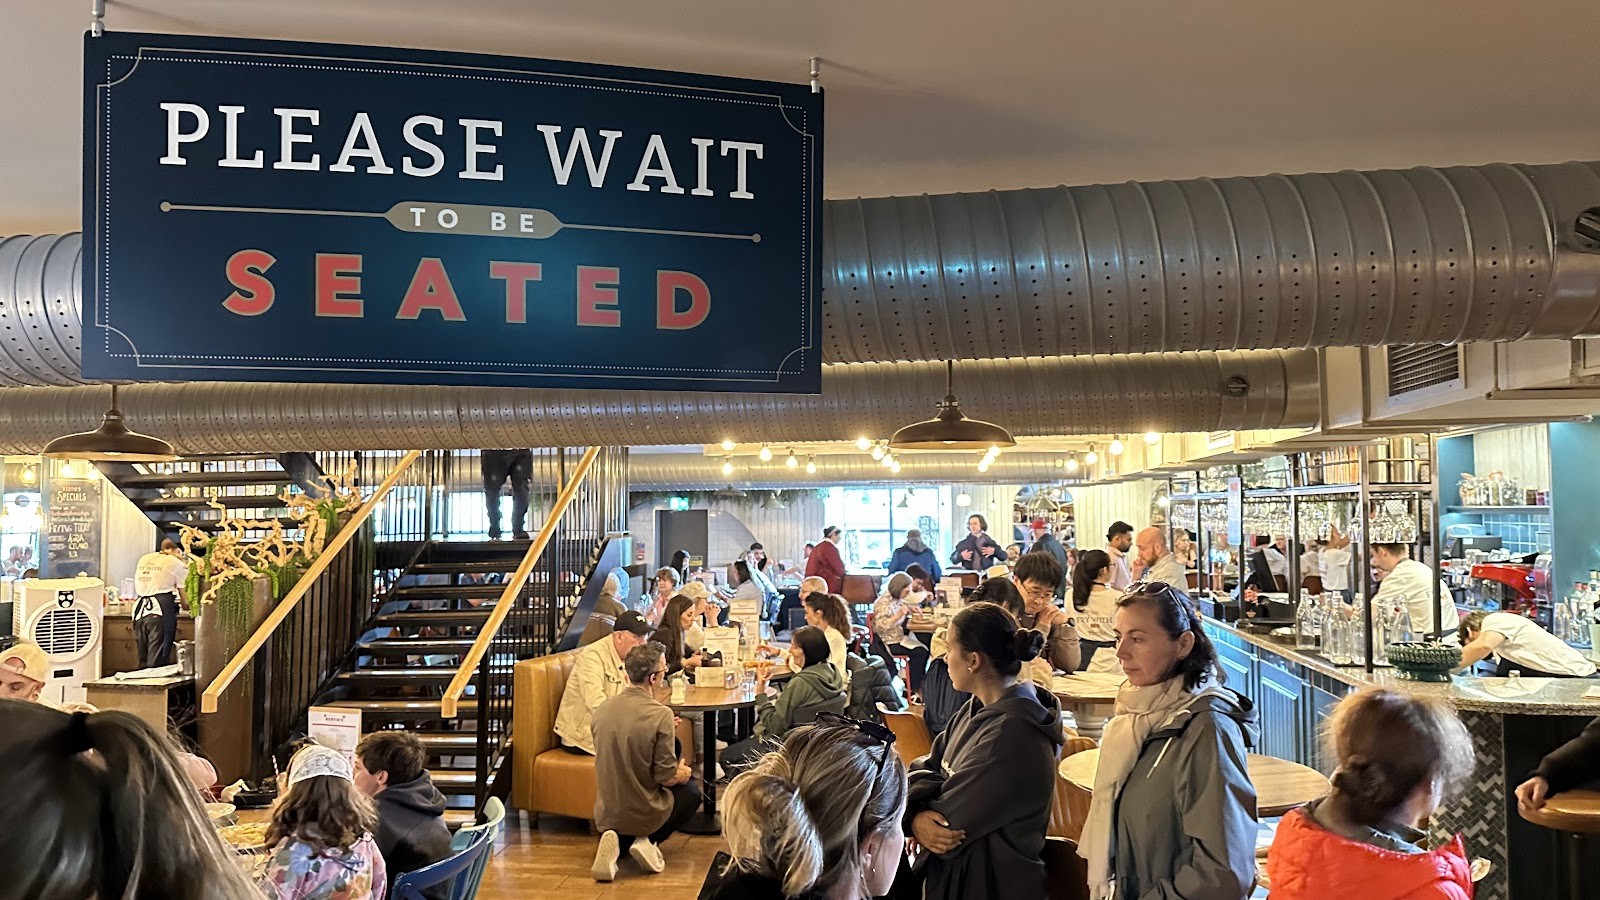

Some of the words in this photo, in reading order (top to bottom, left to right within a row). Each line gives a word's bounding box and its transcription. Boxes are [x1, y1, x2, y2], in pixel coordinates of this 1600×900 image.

[158, 102, 504, 181] PLEASE
[536, 123, 765, 200] WAIT
[410, 206, 459, 230] TO
[490, 211, 535, 233] BE
[221, 248, 712, 331] SEATED
[57, 491, 87, 503] SPECIALS
[48, 523, 73, 533] FRYING
